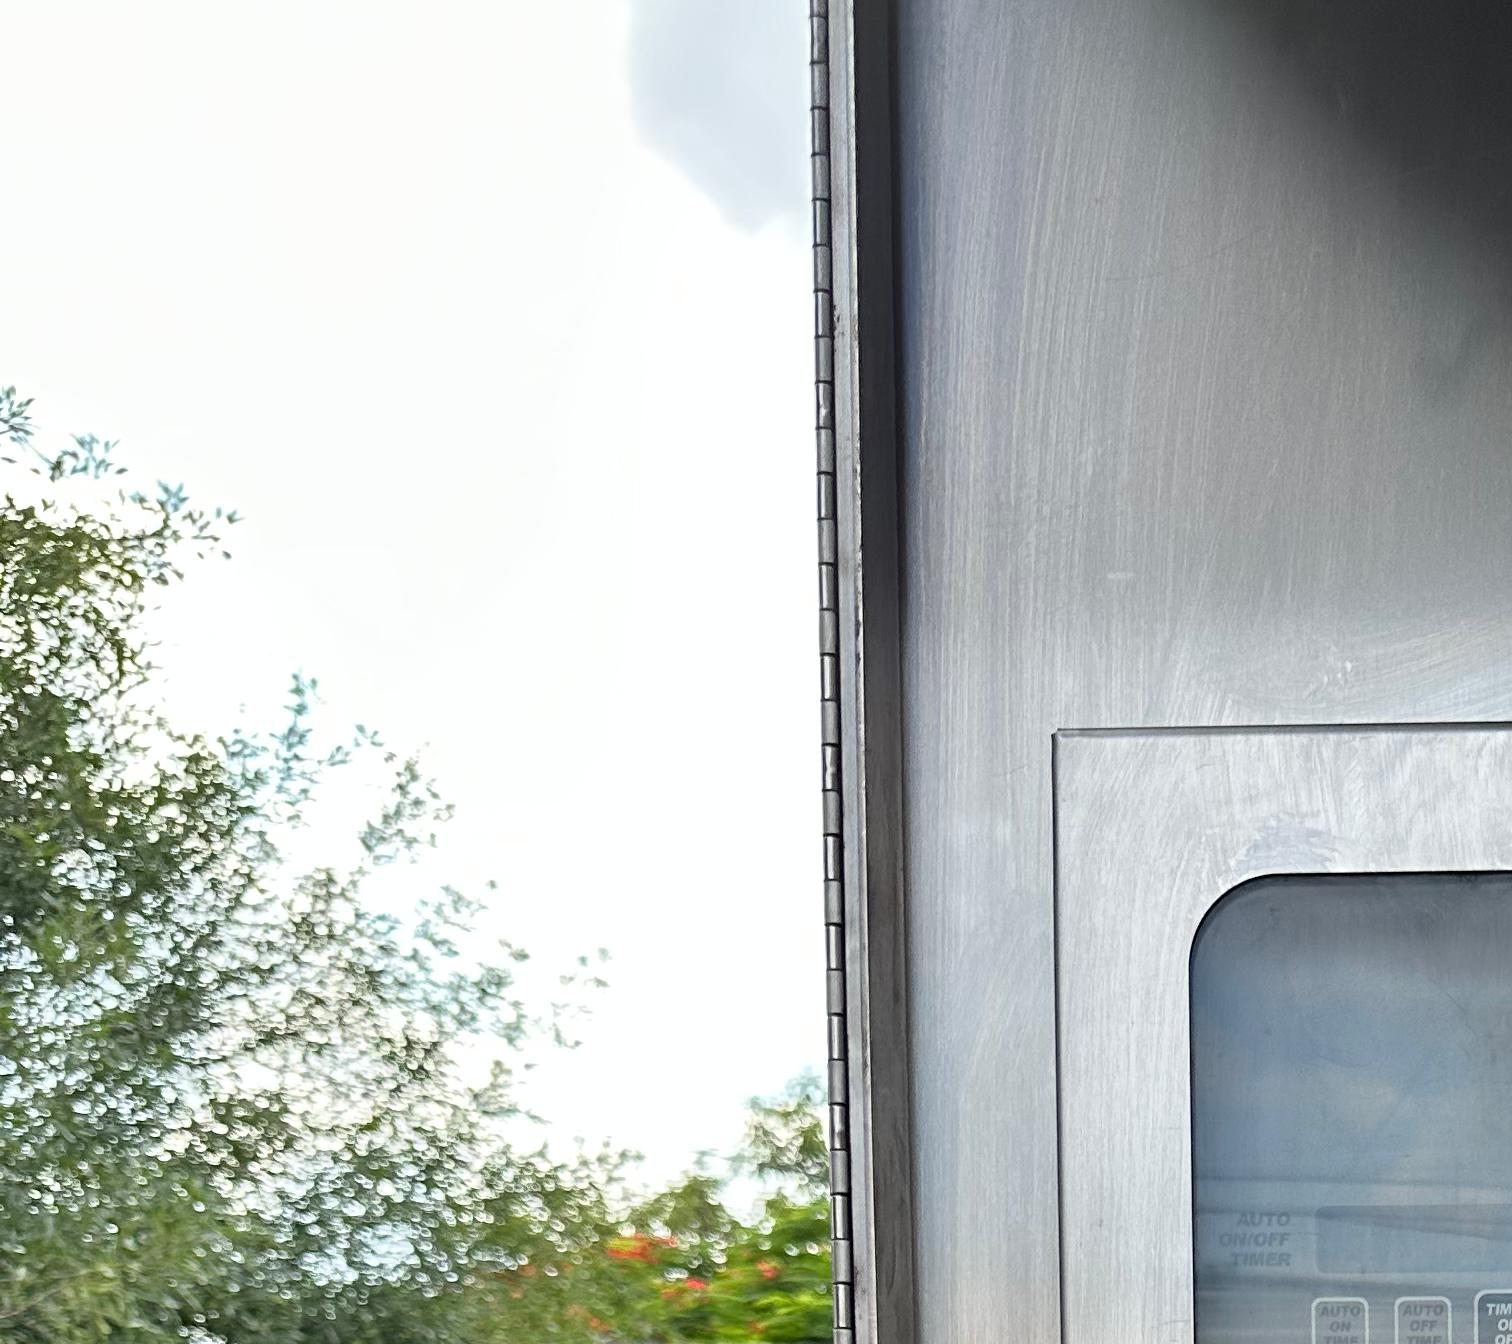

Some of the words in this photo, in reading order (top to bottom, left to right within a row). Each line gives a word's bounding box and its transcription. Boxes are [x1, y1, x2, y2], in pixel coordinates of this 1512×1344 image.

[1237, 1212, 1290, 1227] AUTO
[1218, 1232, 1290, 1248] ON/OFF
[1230, 1252, 1291, 1267] TIMER
[1319, 1304, 1361, 1318] AUTO
[1402, 1304, 1444, 1317] AUTO
[1329, 1320, 1352, 1333] ON
[1409, 1319, 1438, 1333] OFF
